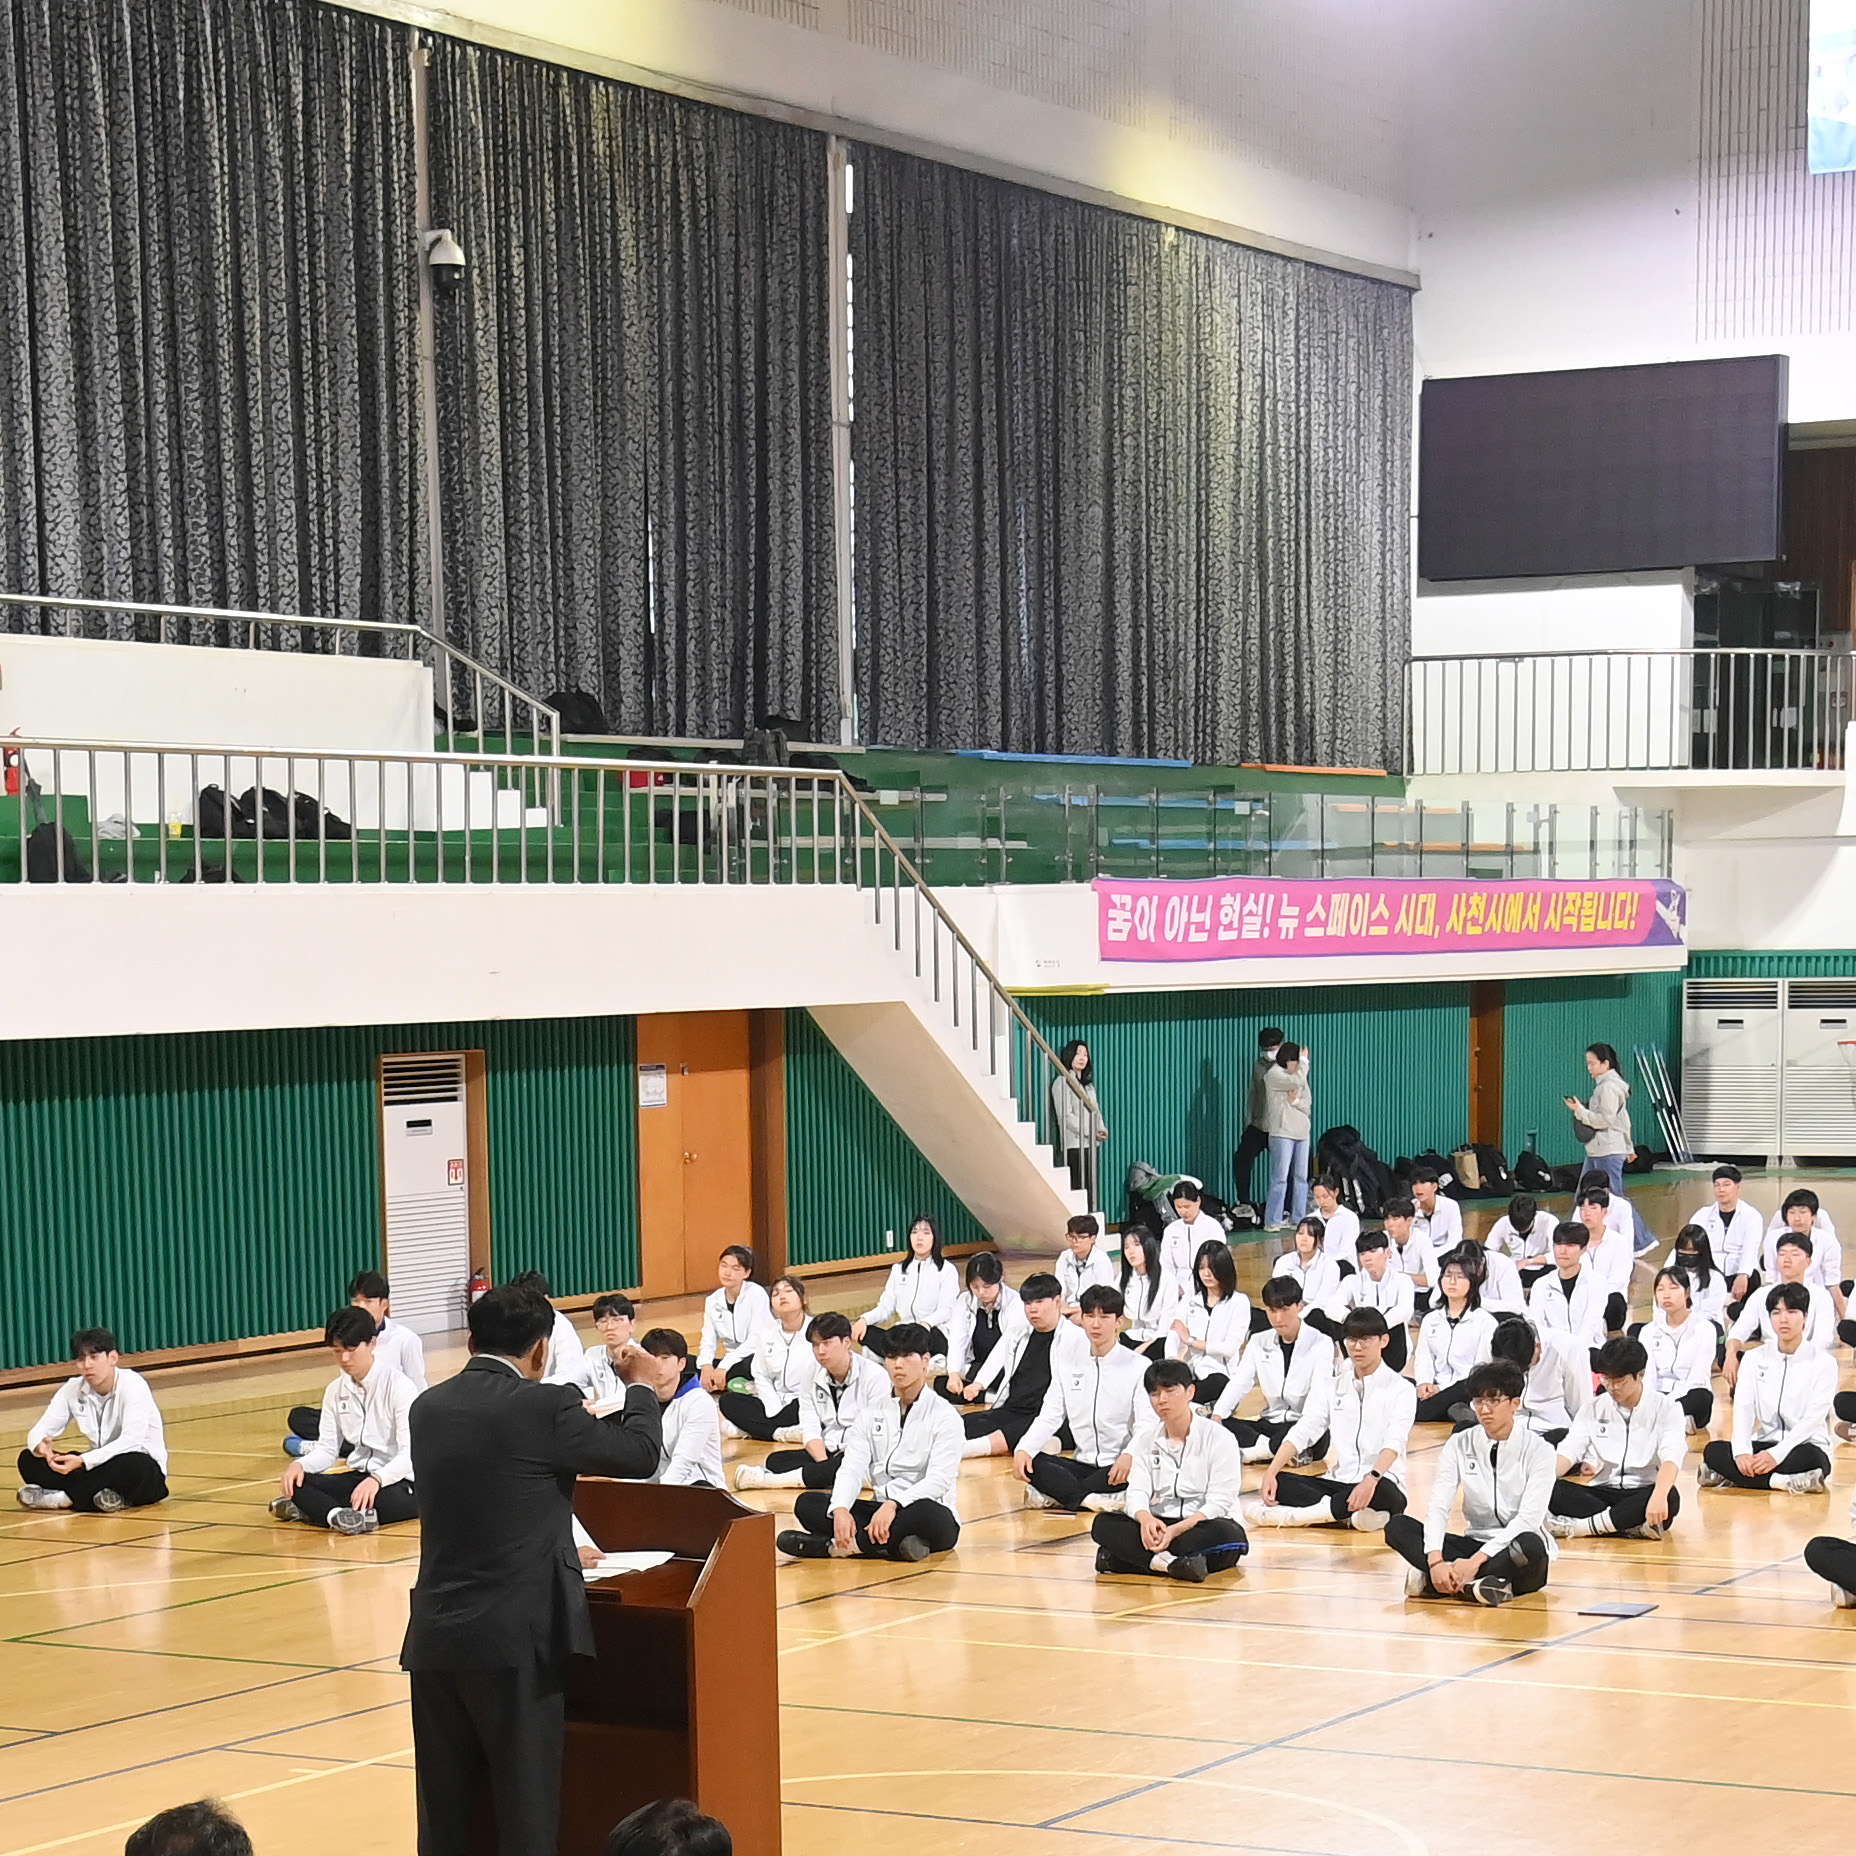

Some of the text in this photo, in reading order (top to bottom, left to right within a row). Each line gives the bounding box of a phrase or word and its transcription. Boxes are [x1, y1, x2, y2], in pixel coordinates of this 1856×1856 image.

[1107, 891, 1640, 943] 꿈이 아닌 현실! 뉴 스페이스 시대, 사천시에서 시작됩니다!
